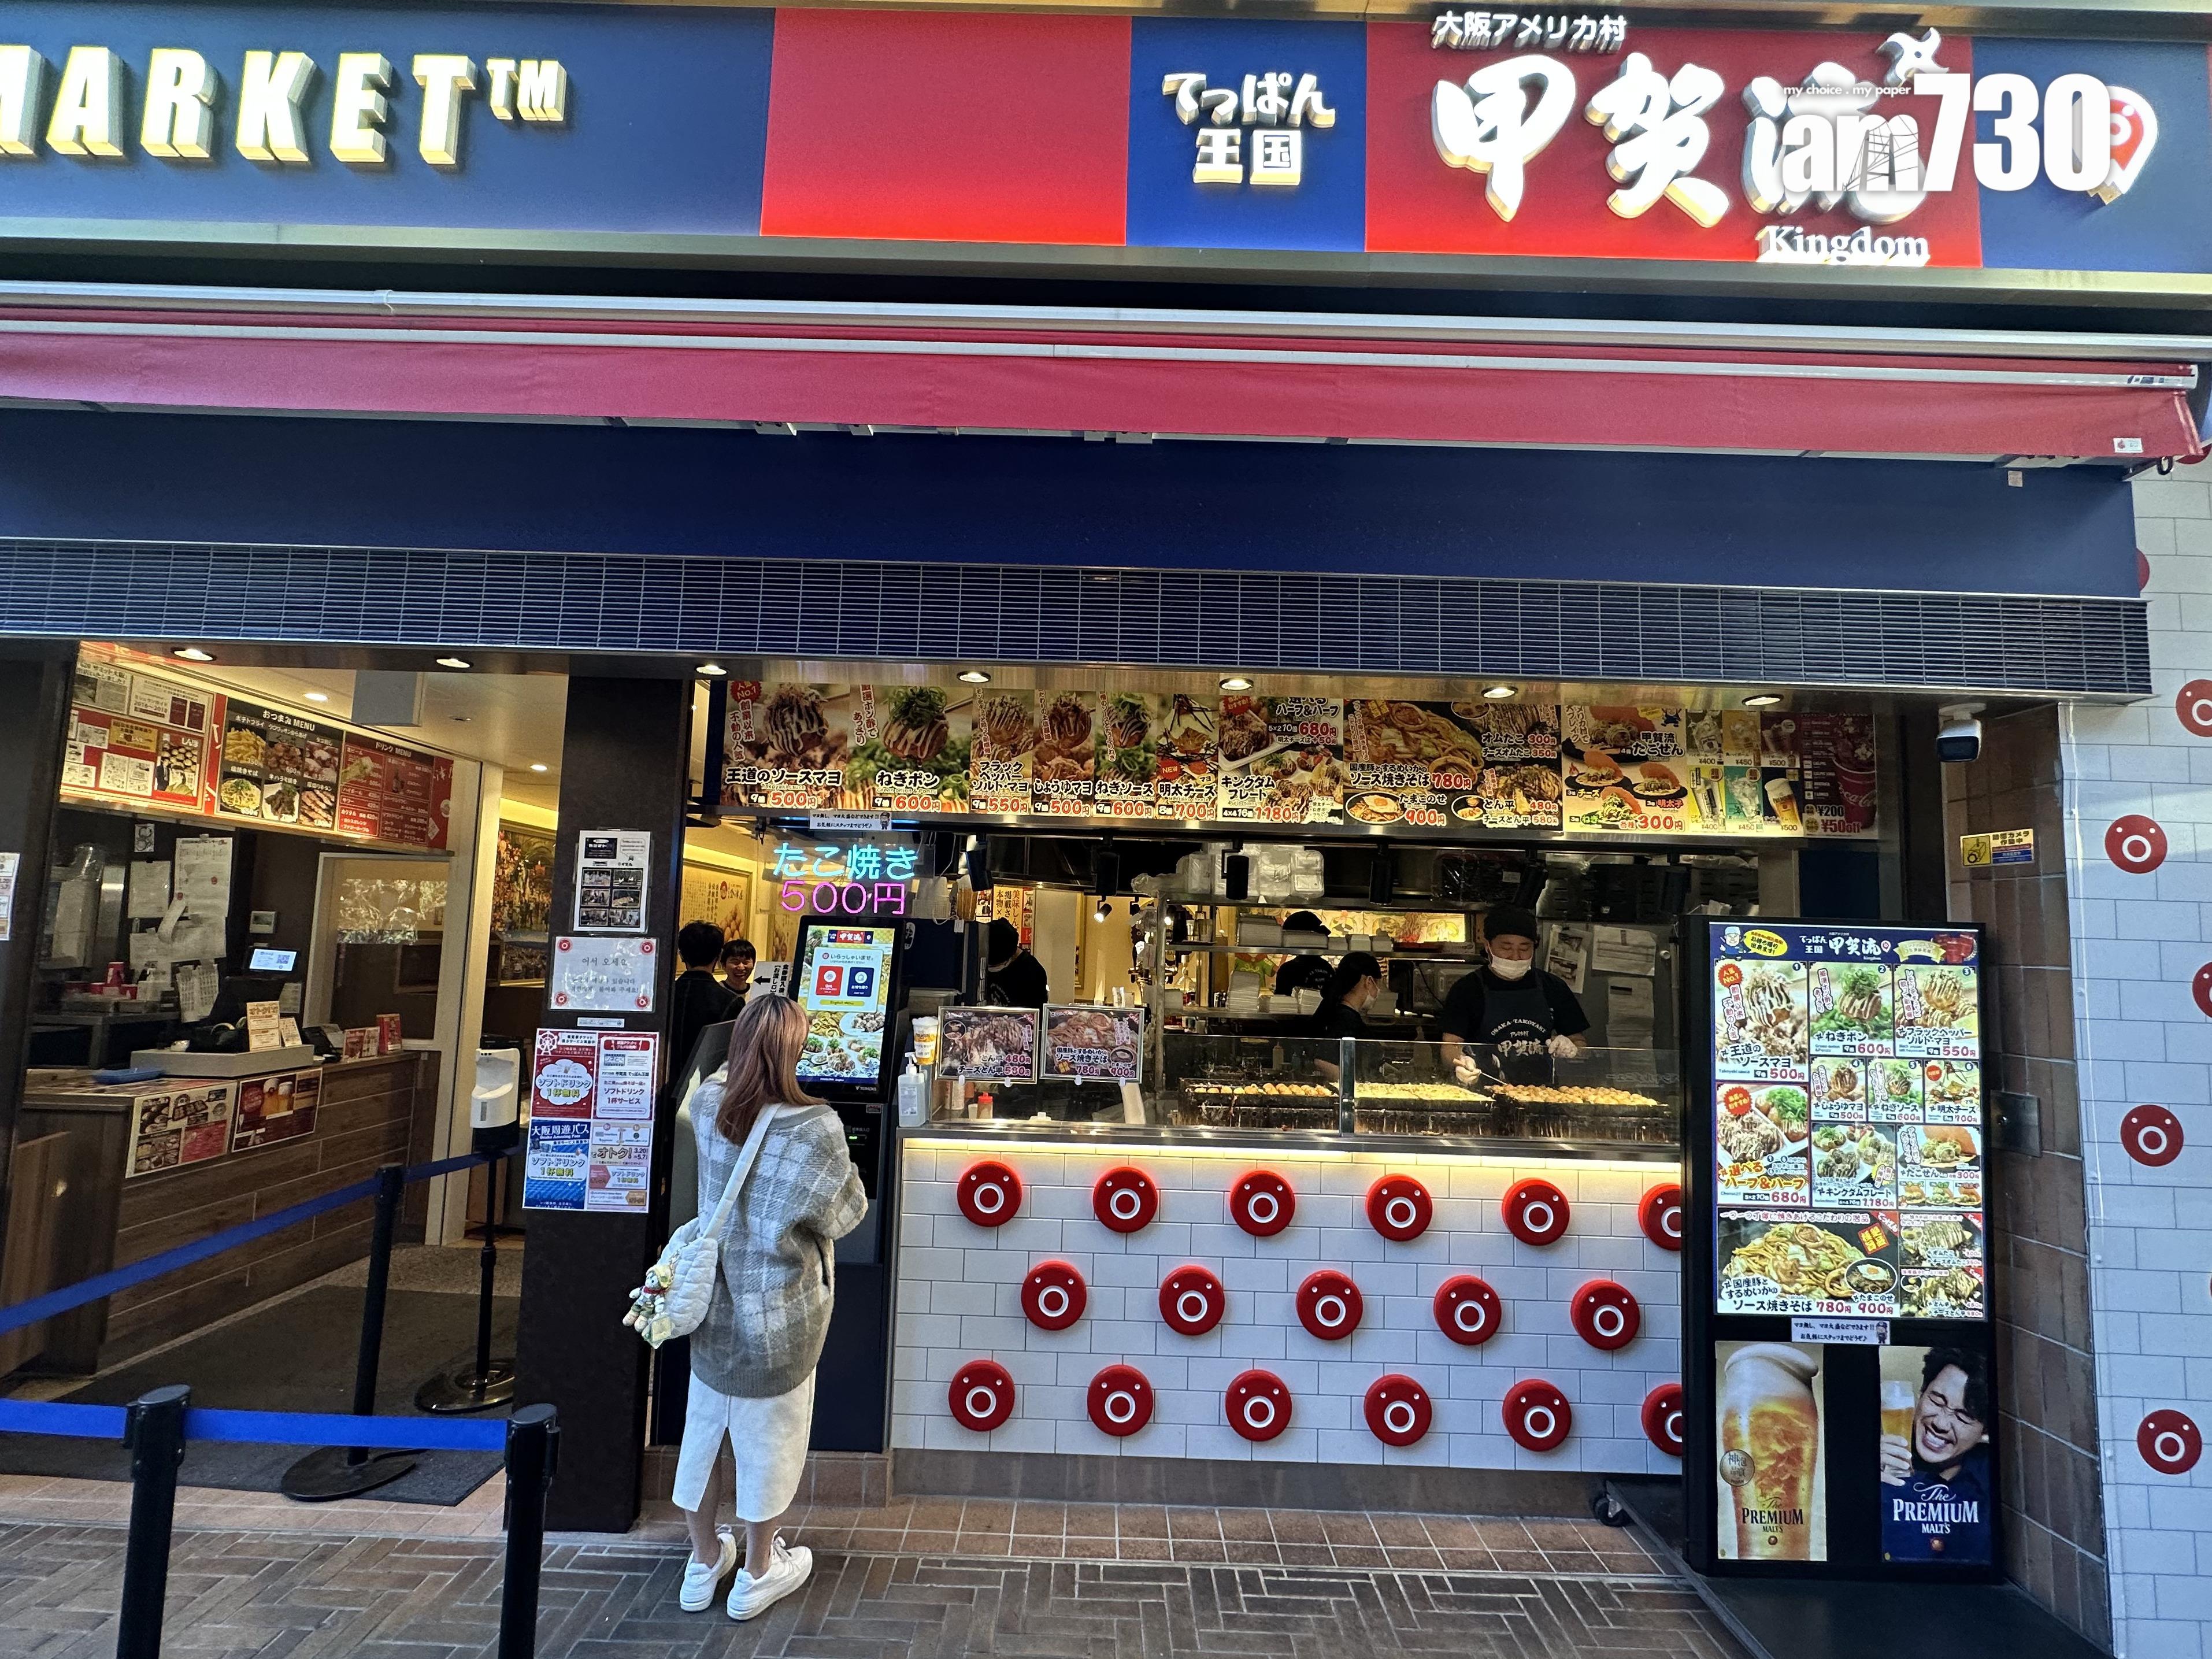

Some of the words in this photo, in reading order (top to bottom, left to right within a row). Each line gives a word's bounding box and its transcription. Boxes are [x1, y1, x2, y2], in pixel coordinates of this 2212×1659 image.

[1431, 11, 1626, 53] 大阪アメリカ村
[1162, 72, 1335, 128] てっぱん
[1192, 128, 1302, 186] 王国
[1756, 225, 1931, 266] Kingdom
[1276, 704, 1340, 717] ハーフ&ハーフ
[263, 710, 292, 725] おつまみ
[293, 719, 315, 732] MENU
[853, 712, 866, 746] あっさり
[1299, 722, 1337, 738] 680円
[1481, 732, 1525, 745] オムたこ
[1528, 734, 1557, 745] 300円
[1642, 731, 1676, 744] 甲賀流
[375, 741, 394, 753] ドリンク
[1481, 747, 1531, 758] チーズオムたこ
[979, 761, 1024, 772] ブラック
[1162, 765, 1178, 774] NEW
[725, 766, 842, 787] 王道のソースマヨ
[876, 770, 940, 789] ねぎポン
[979, 771, 1023, 781] ペッパー
[1221, 775, 1277, 790] キングダム
[1350, 772, 1432, 787] ソース焼きそば
[1432, 772, 1473, 790] 780円
[1033, 779, 1092, 795] しょうゆマヨ
[1095, 782, 1155, 797] ねぎソース
[1159, 783, 1217, 798] 明太チーズ
[1578, 789, 1601, 798] チーズ
[770, 791, 818, 808] 500円
[1228, 788, 1268, 802] プレート
[895, 795, 942, 812] 600円
[988, 797, 1029, 814] 550円
[1050, 799, 1091, 817] 500円
[1113, 801, 1153, 819] 600円
[1483, 798, 1516, 812] とん平
[1529, 799, 1559, 812] 480円
[1657, 799, 1684, 809] 明太子
[1175, 803, 1215, 820] 700円
[1817, 805, 1846, 817] ¥200
[1405, 809, 1447, 827] 900円
[1483, 814, 1532, 826] チーズとん平
[1637, 814, 1685, 832] 300円
[773, 842, 918, 880] たこ焼き
[781, 880, 906, 915] 500円
[1799, 935, 1828, 944] てっぱん
[1828, 936, 1881, 956] 甲賀流
[1805, 945, 1823, 954] 王国
[582, 957, 598, 966] 어서
[602, 958, 628, 966] 오세요
[1722, 972, 1739, 984] No.1
[1825, 1031, 1867, 1042] ねぎポン
[1730, 1043, 1761, 1057] 王道の
[1857, 1043, 1891, 1055] 600円
[1942, 1046, 1976, 1057] 550円
[1004, 1054, 1031, 1065] 480円
[1056, 1054, 1108, 1064] ソース焼きそば
[1740, 1056, 1791, 1068] ソースマヨ
[958, 1065, 1004, 1076] チーズとん平
[1110, 1066, 1136, 1078] 900円
[1769, 1068, 1805, 1080] 500円
[538, 1079, 591, 1089] ソフトドリンク
[1821, 1102, 1863, 1111] しょうゆマヨ
[1881, 1103, 1918, 1113] ねぎソース
[1937, 1105, 1977, 1114] 明太チーズ
[1840, 1112, 1863, 1120] 500円
[531, 1123, 590, 1136] 大阪周遊パス
[531, 1157, 586, 1168] ソフトドリンク
[1724, 1175, 1805, 1192] ハーフ&ハーフ
[1771, 1191, 1807, 1203] 680円
[1733, 1278, 1769, 1289] 国産豚と
[1726, 1287, 1779, 1299] するめいかの
[1733, 1300, 1813, 1313] ソース焼きそば
[1816, 1301, 1852, 1314] 780円
[1858, 1302, 1894, 1315] 900円
[1913, 1482, 1956, 1502] The
[1742, 1507, 1804, 1525] PREMIUM
[1892, 1498, 1980, 1524] PREMIUM
